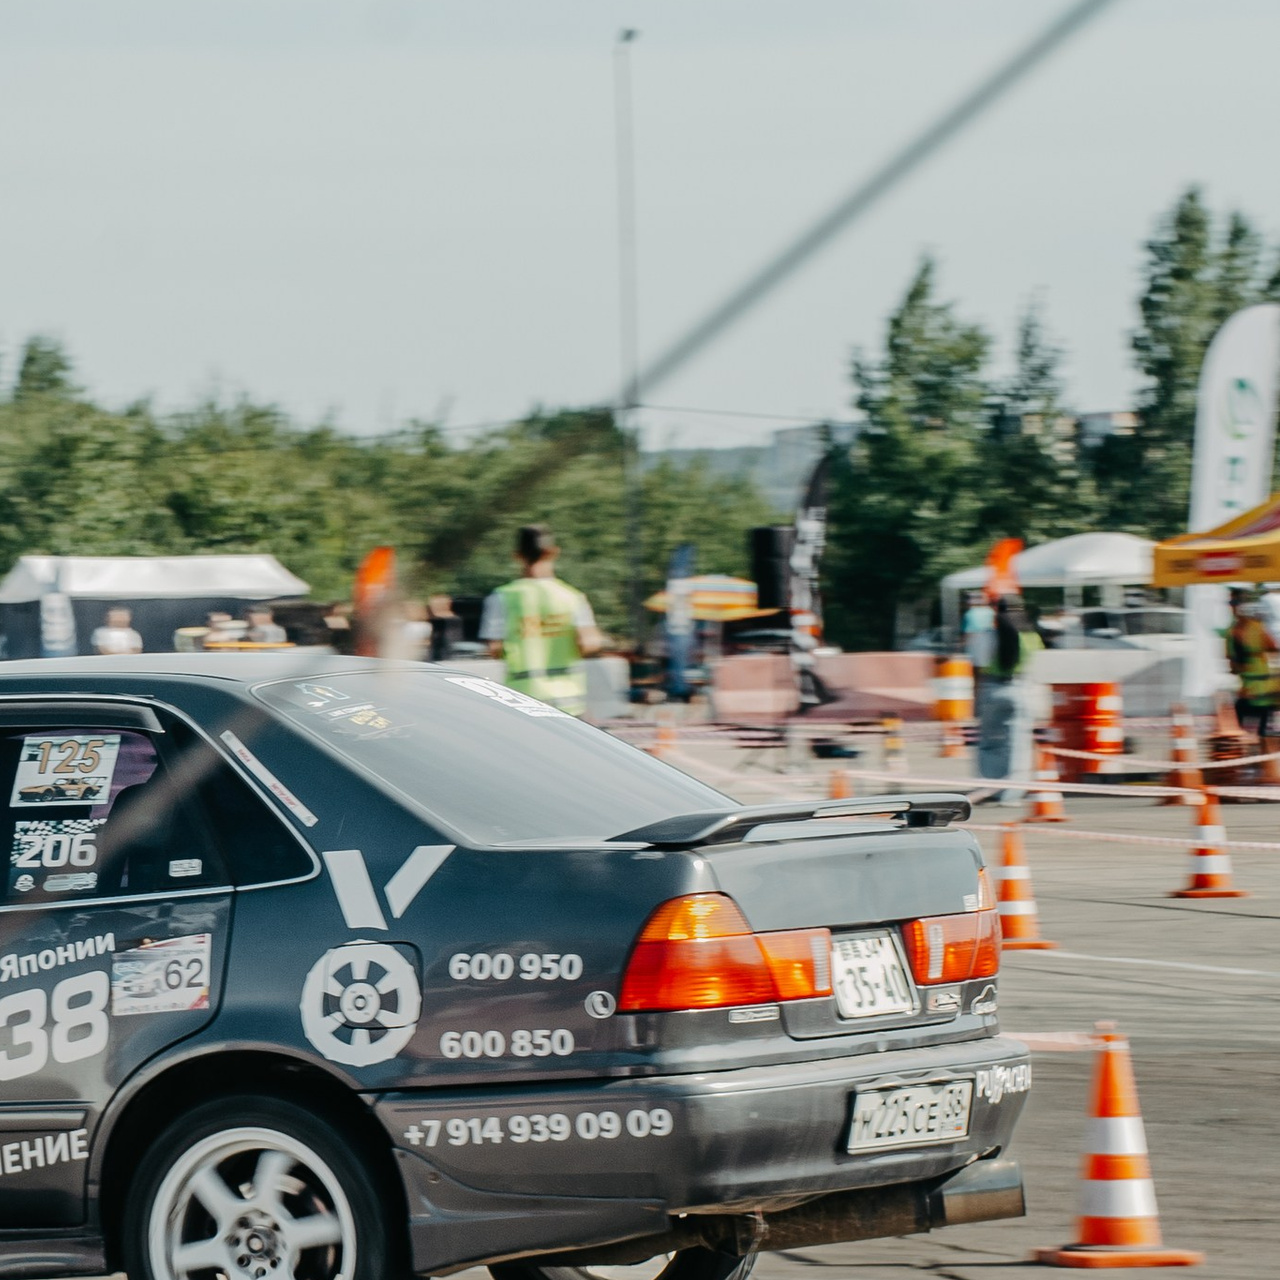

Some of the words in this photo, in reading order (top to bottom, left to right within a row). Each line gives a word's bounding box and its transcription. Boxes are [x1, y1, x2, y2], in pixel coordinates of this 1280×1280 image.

[37, 739, 105, 774] 125
[15, 832, 98, 868] 206
[165, 958, 203, 990] 62
[448, 952, 514, 981] 600
[519, 953, 584, 981] 950
[439, 1030, 506, 1059] 600
[510, 1028, 575, 1057] 850
[403, 1119, 442, 1147] +7
[445, 1116, 504, 1146] 914
[508, 1113, 571, 1143] 939
[575, 1110, 621, 1140] 09
[626, 1108, 674, 1138] 09
